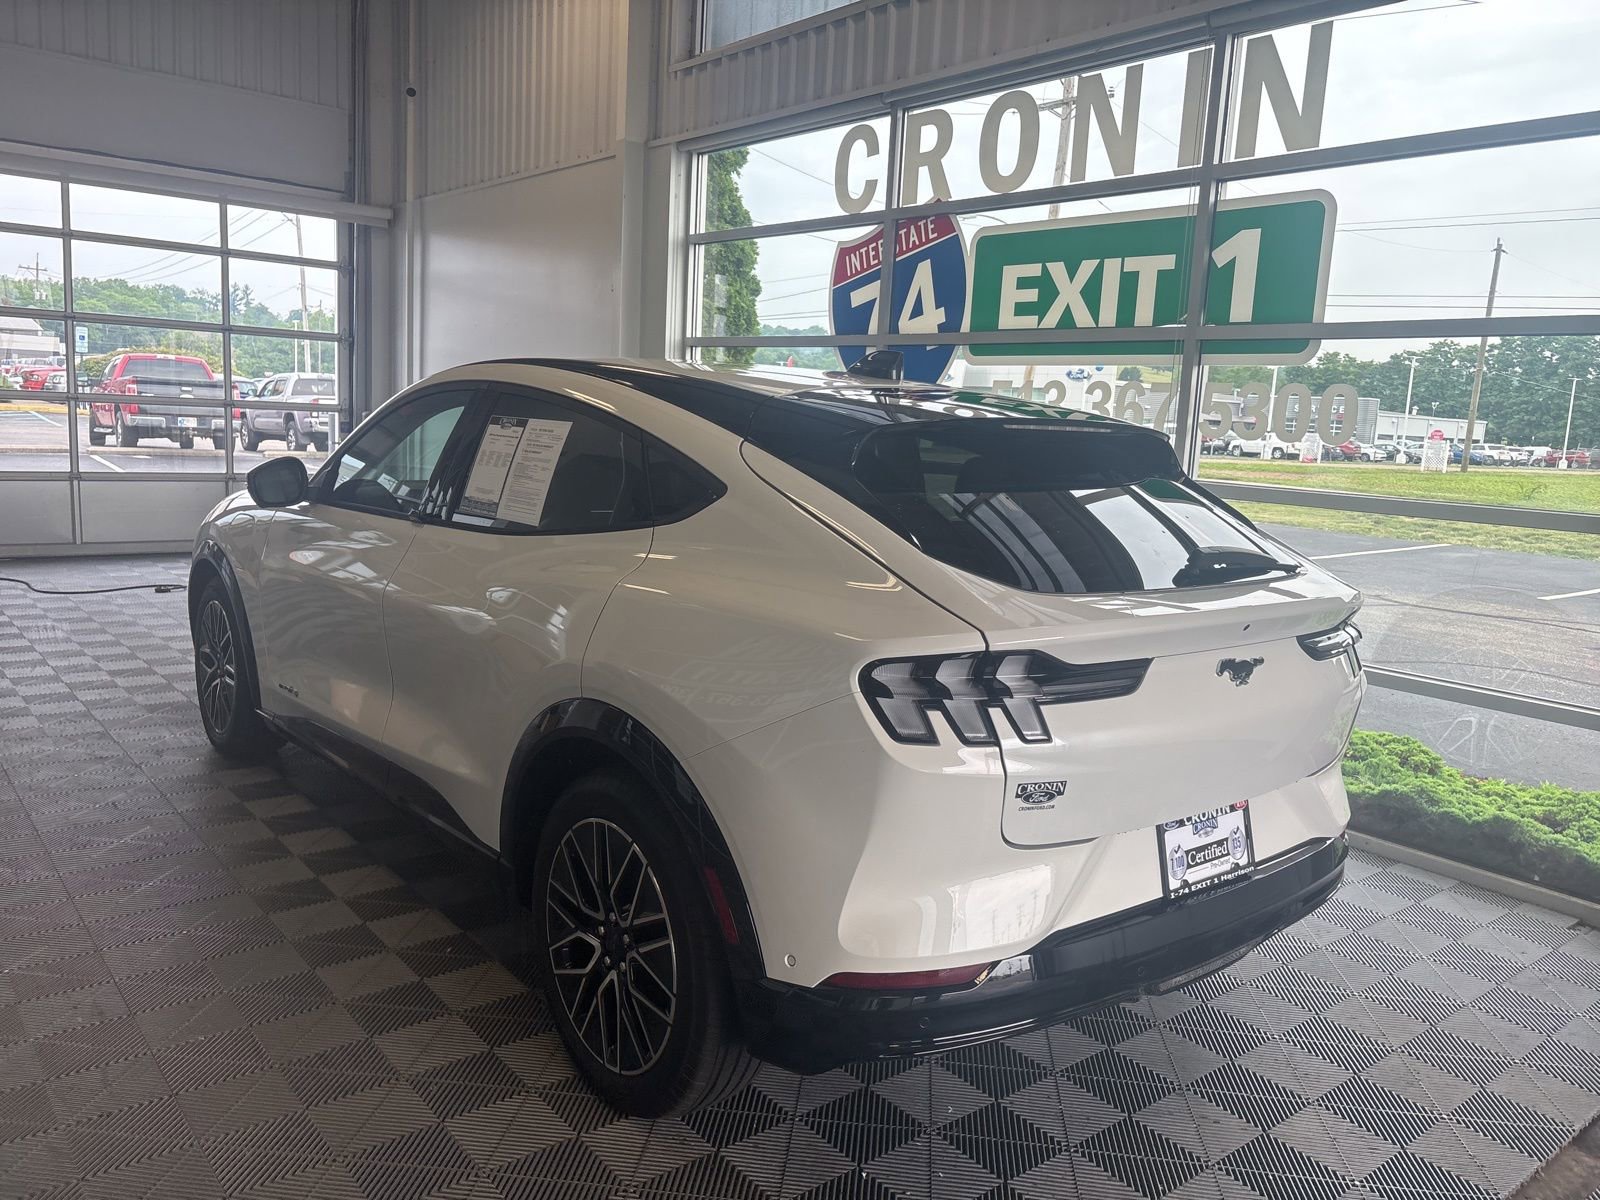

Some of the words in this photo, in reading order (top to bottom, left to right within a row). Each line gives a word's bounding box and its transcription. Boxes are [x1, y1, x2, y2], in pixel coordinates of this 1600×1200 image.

[835, 21, 1334, 215] CRONIN
[846, 216, 938, 277] INTETATE
[998, 254, 1176, 330] EXIT
[1211, 228, 1262, 323] 1
[1085, 380, 1177, 431] 367
[1200, 383, 1358, 446] 5300
[1294, 404, 1345, 413] SRCE
[1018, 782, 1065, 794] CRONIN
[1029, 792, 1050, 802] Ford
[1184, 806, 1230, 824] CRONIN
[1193, 818, 1218, 834] CRONIN
[1188, 842, 1227, 865] Certified
[1170, 887, 1189, 899] I-74
[1191, 880, 1213, 892] EXIT
[1221, 866, 1254, 881] Harrison
